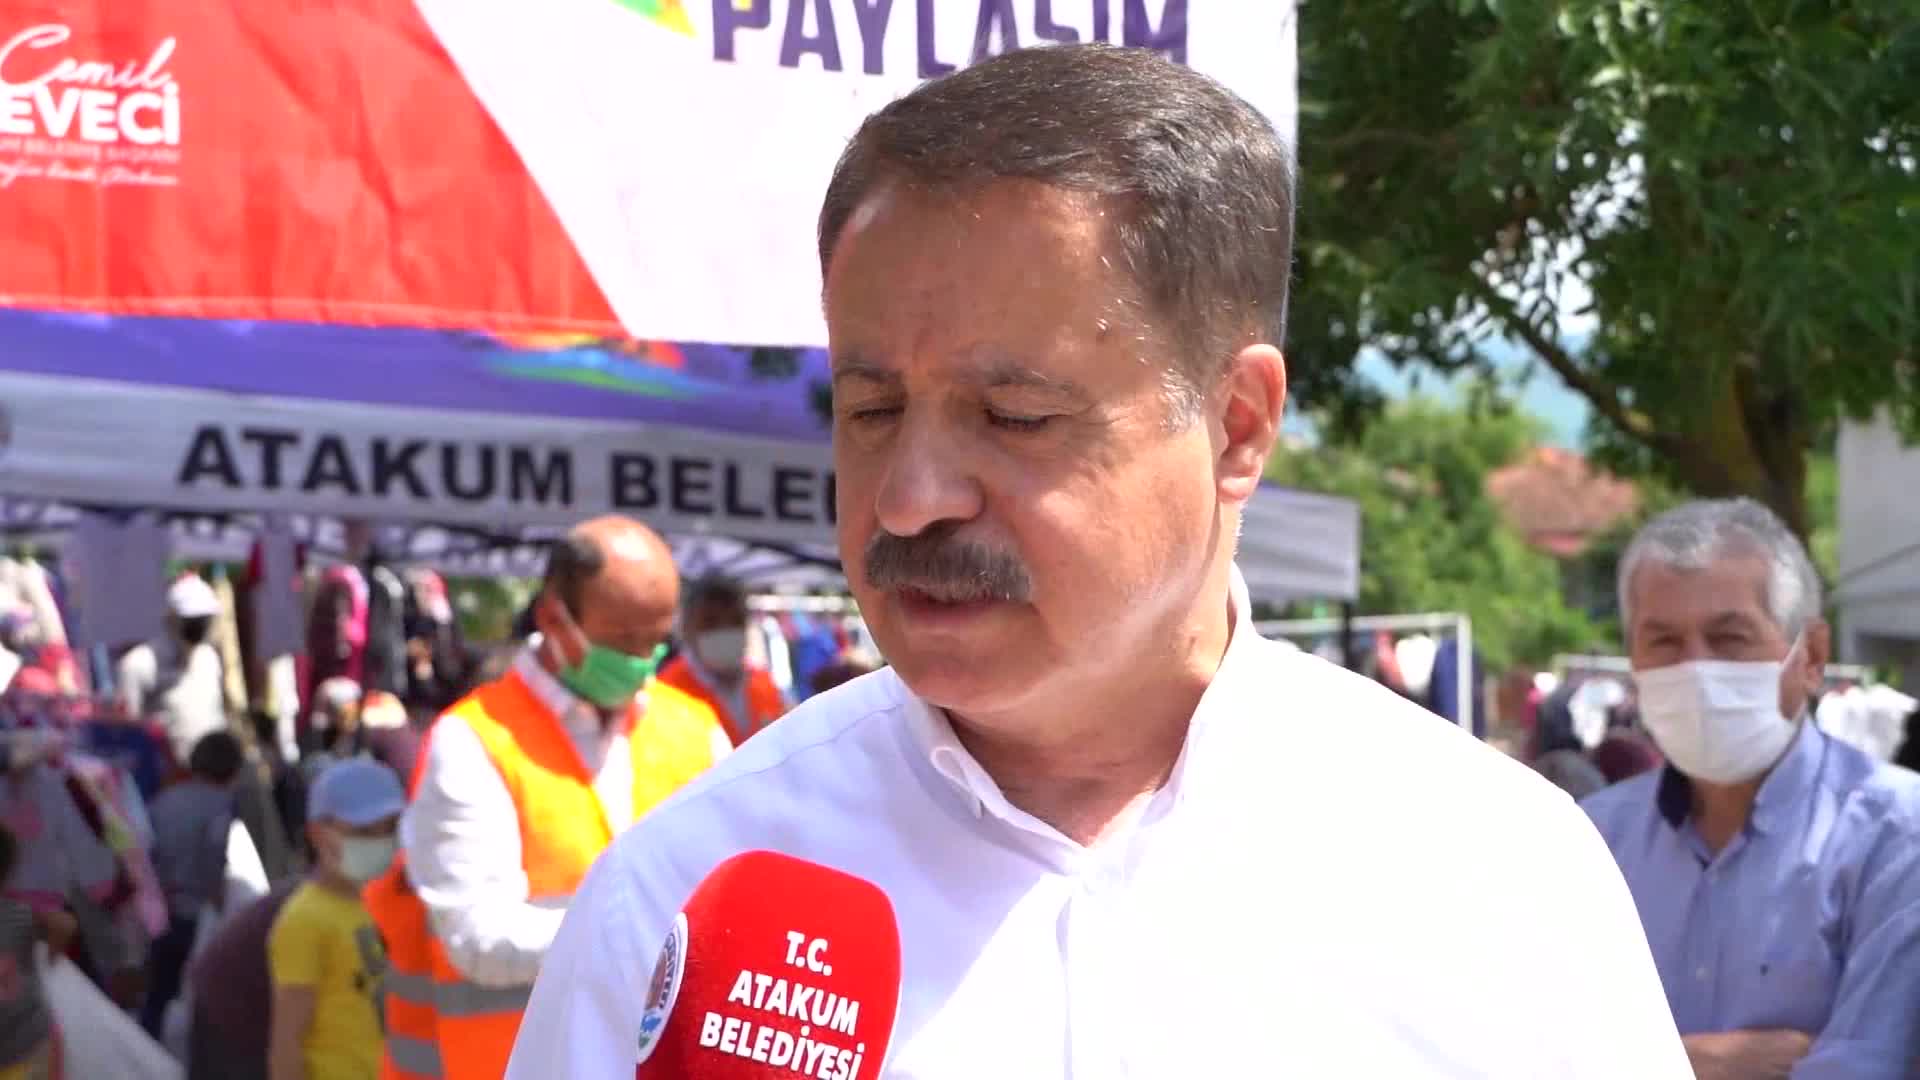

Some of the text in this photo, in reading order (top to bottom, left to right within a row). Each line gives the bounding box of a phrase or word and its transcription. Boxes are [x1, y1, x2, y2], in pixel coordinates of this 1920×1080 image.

[0, 23, 177, 88] Cemil
[177, 425, 575, 507] ATAKUM
[785, 930, 833, 977] T.C.
[727, 969, 860, 1036] ATAKUM
[699, 1011, 865, 1080] BELEDİYESİ
